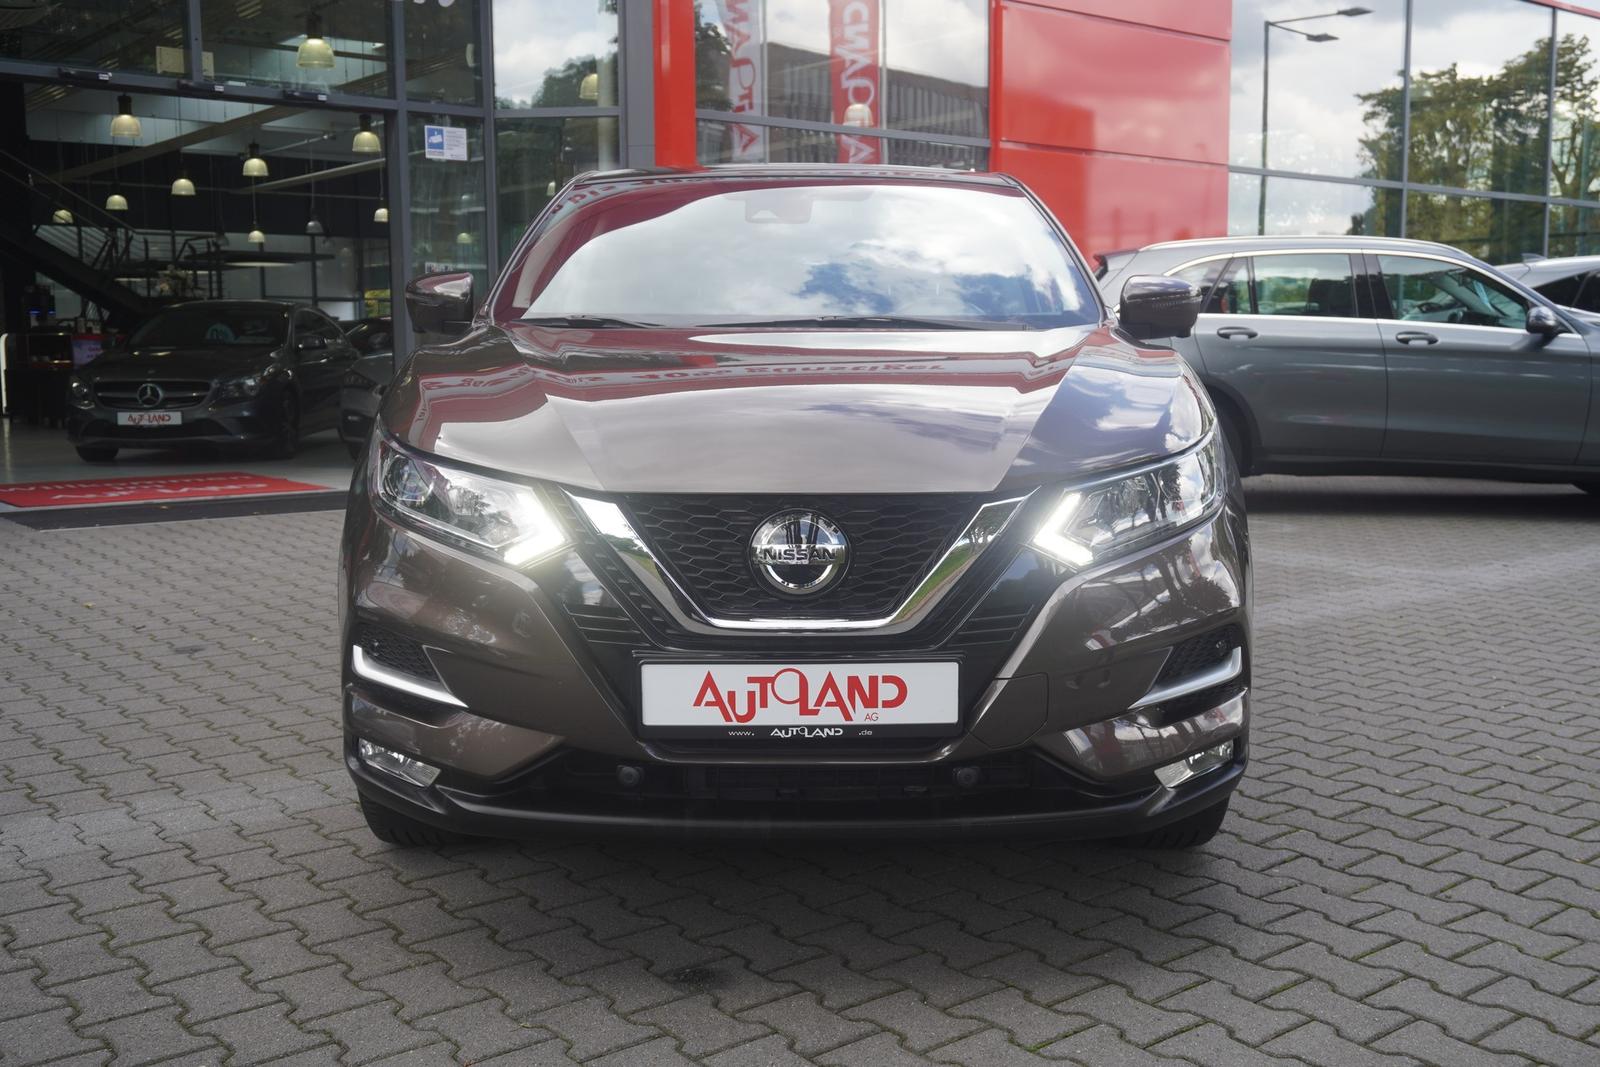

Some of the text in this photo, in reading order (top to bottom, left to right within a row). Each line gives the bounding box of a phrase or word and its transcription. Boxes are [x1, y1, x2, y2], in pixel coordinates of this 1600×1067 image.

[127, 413, 171, 425] AUTLAND
[763, 547, 835, 561] NISSAN
[693, 668, 908, 723] AUTOLAND AG
[770, 726, 843, 738] AUTOLAND
